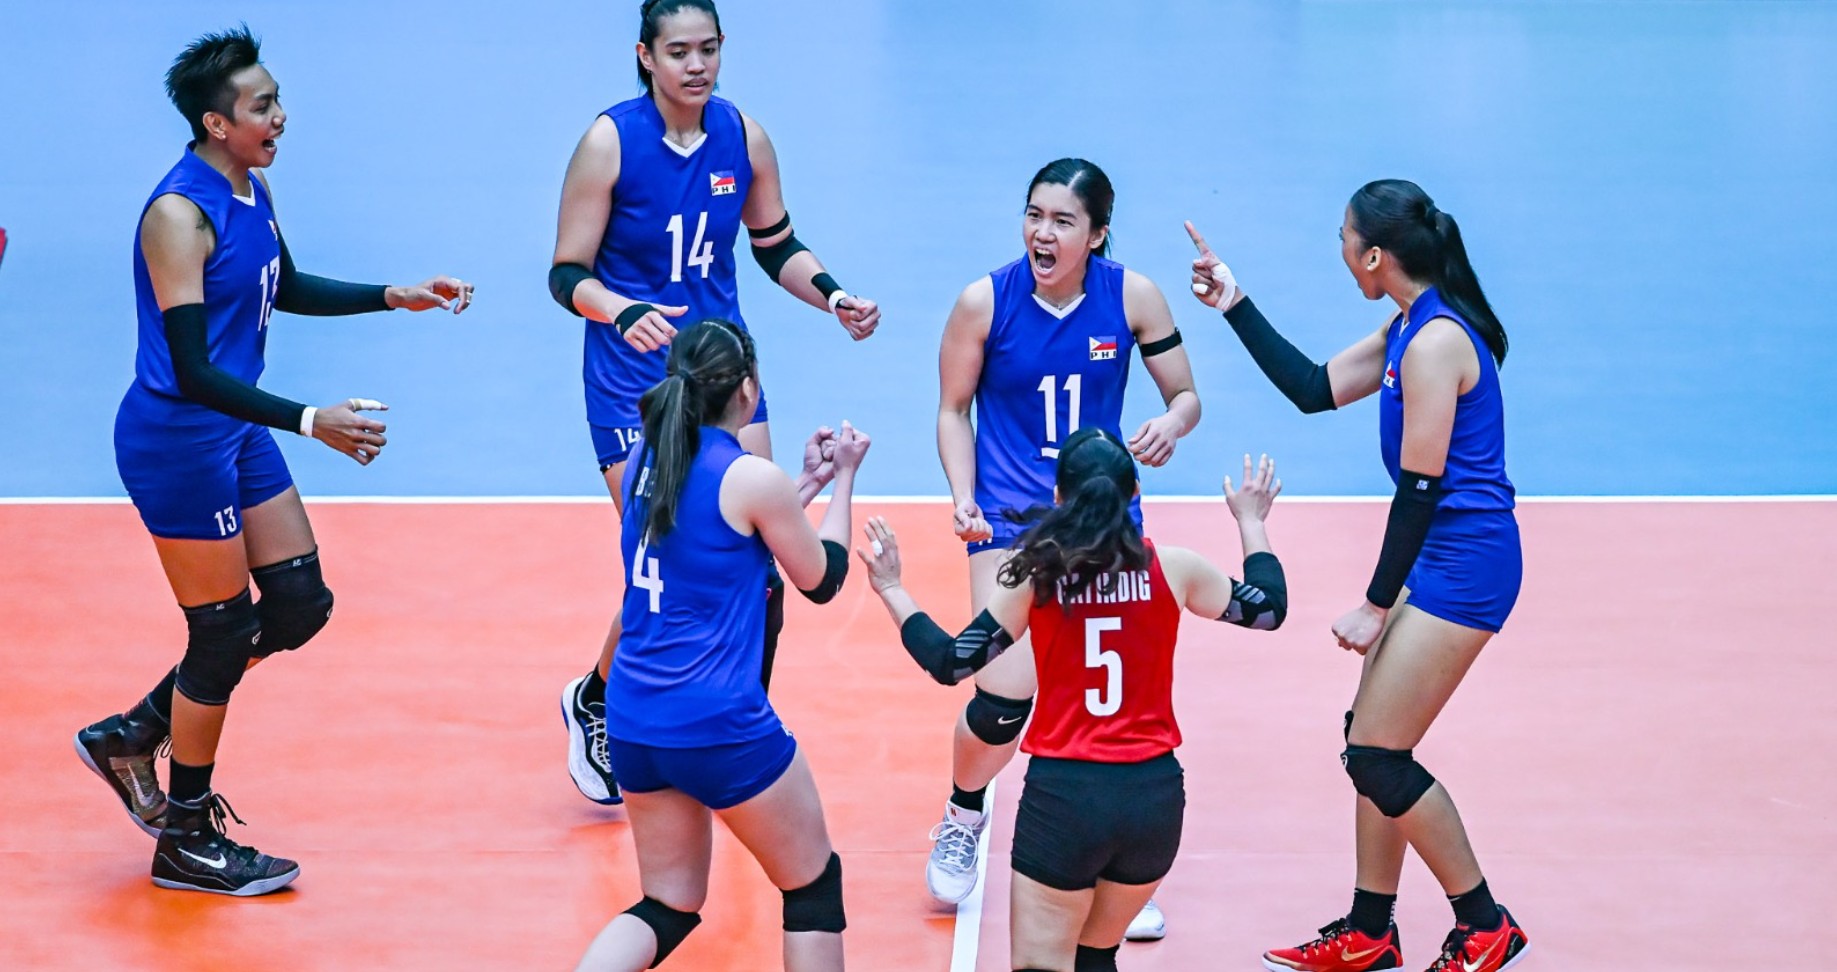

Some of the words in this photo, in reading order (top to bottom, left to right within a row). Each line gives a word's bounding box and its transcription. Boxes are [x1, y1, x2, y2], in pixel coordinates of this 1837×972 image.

[711, 184, 736, 194] PHI
[665, 211, 715, 282] 14
[1090, 350, 1117, 359] PHI
[1037, 374, 1081, 442] 11
[614, 427, 641, 451] 14
[214, 505, 237, 536] 13
[632, 525, 664, 613] 4
[1084, 616, 1123, 717] 5
